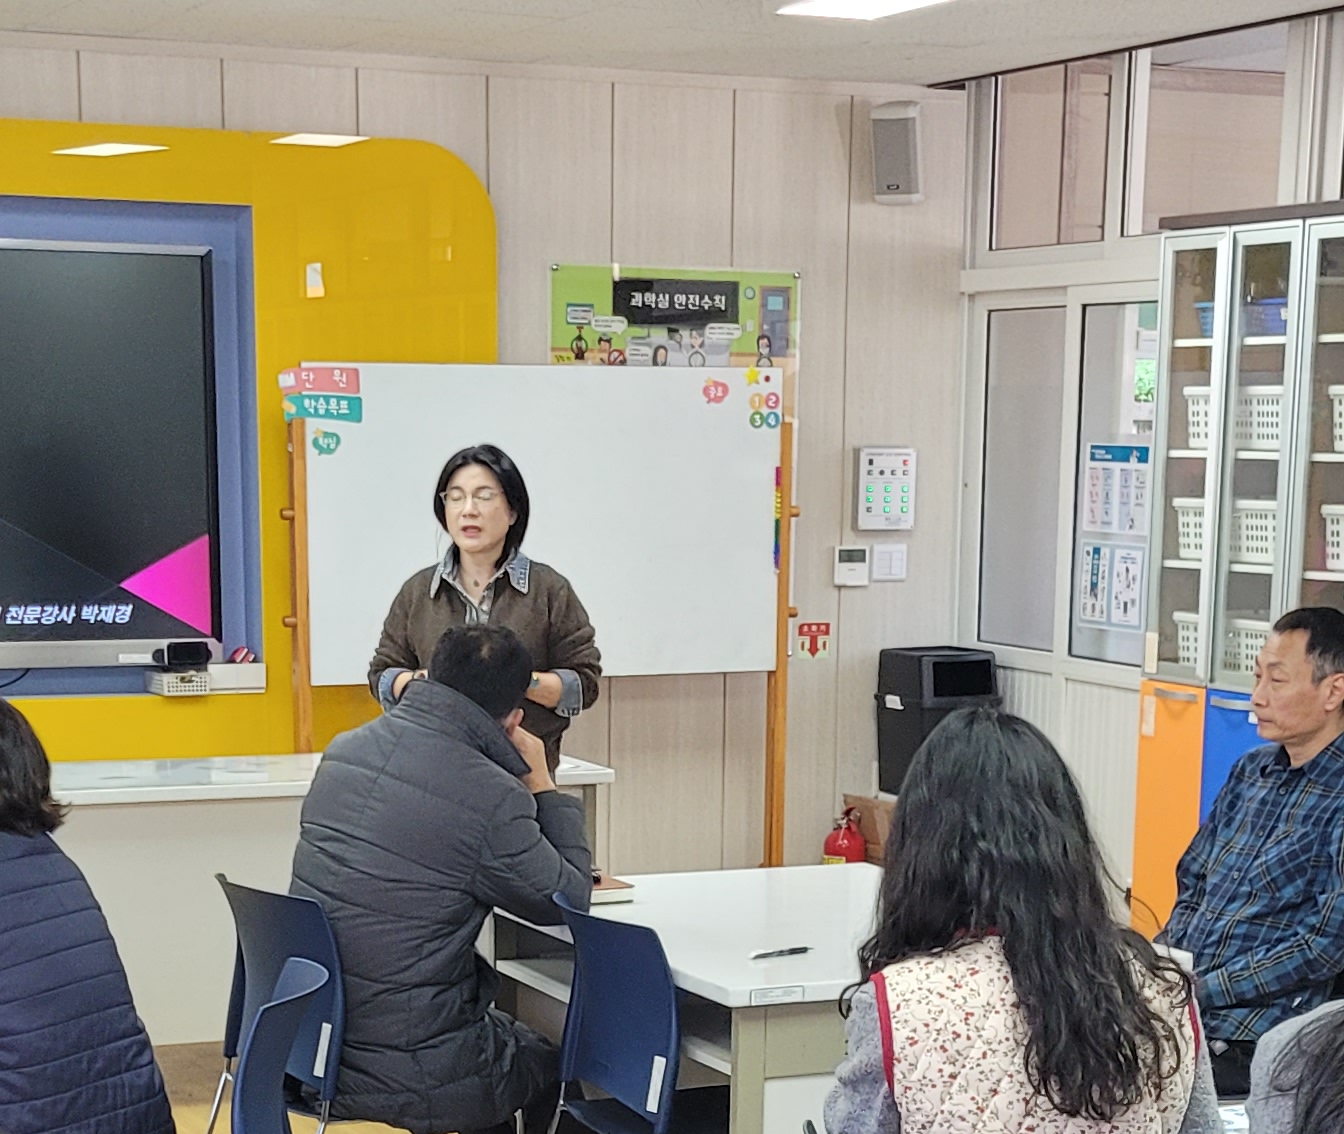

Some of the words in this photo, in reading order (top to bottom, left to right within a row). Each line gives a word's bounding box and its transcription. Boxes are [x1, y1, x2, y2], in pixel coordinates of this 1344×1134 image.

[629, 290, 670, 309] 과학실
[673, 292, 726, 311] 안전수칙
[303, 397, 351, 415] 학습목표
[767, 394, 777, 408] 2
[753, 413, 762, 426] 3
[767, 413, 777, 427] 4
[5, 603, 76, 625] 전문강사
[80, 602, 134, 624] 박재경
